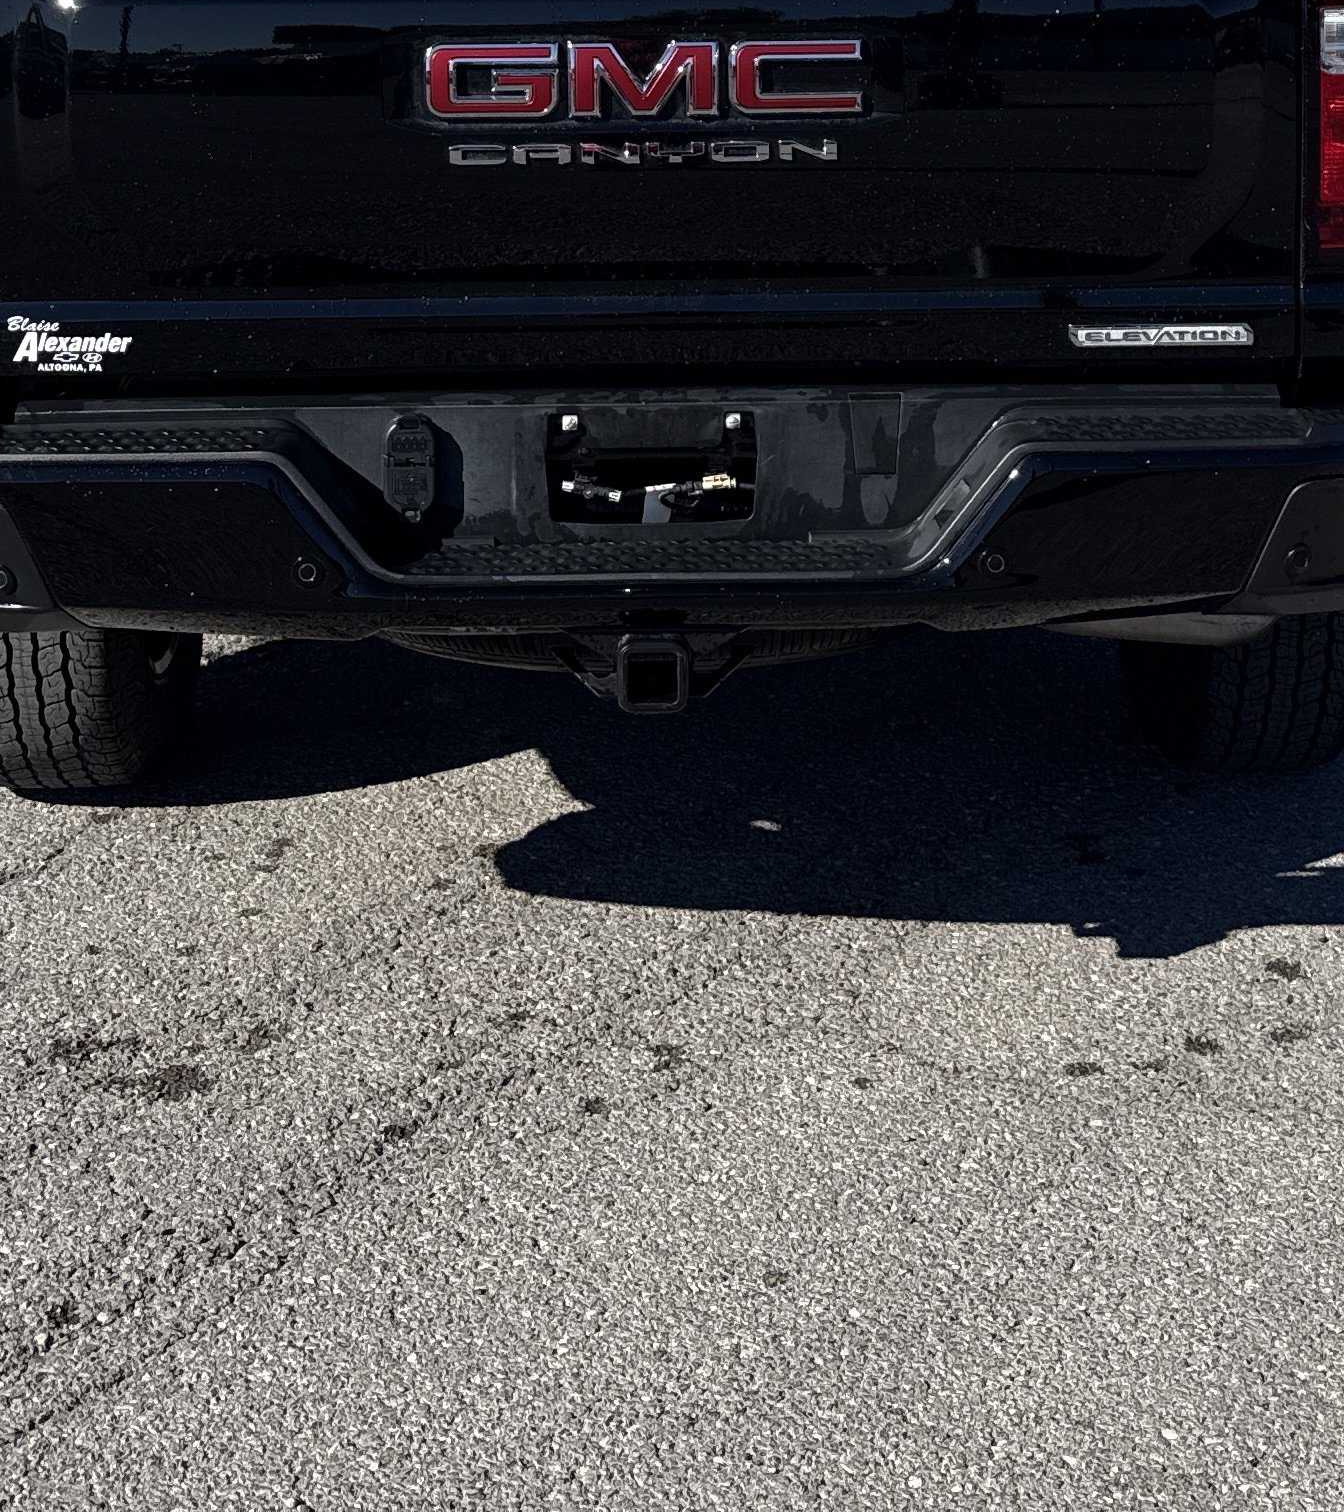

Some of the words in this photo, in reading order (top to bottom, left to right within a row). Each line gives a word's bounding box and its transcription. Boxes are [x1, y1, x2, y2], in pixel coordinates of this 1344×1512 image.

[424, 38, 863, 119] GMC
[448, 138, 839, 166] CANYON
[6, 315, 60, 332] Blaise
[12, 331, 133, 362] Alexander
[1084, 329, 1242, 343] ELEVATION
[37, 362, 87, 373] ALTOONA,
[88, 363, 103, 372] PA
